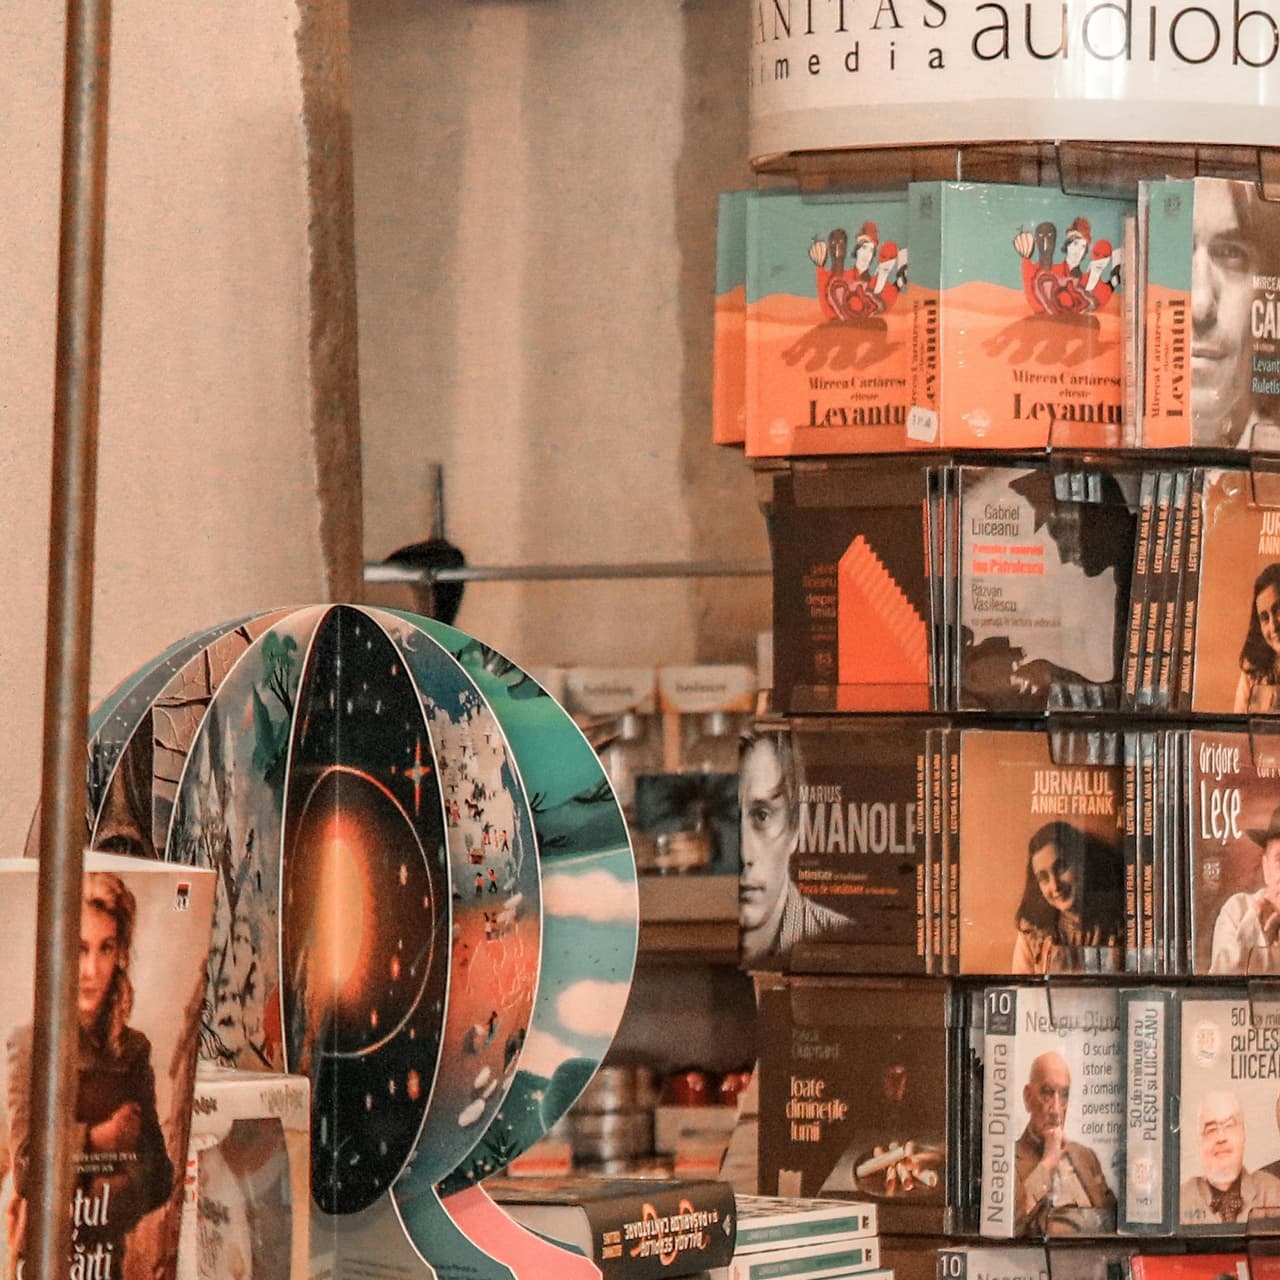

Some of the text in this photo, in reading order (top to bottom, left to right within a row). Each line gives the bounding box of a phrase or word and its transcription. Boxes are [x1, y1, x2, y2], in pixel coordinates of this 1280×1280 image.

[809, 400, 906, 428] Levantu
[1013, 393, 1122, 424] Levantu
[985, 504, 1020, 521] Gabriel
[971, 519, 1020, 537] Liiceanu
[1199, 742, 1239, 781] Grigore
[798, 785, 843, 804] MARIUS
[1031, 770, 1113, 796] JURNALUL
[1030, 795, 1113, 816] ANNEI FRANK
[1200, 780, 1242, 846] Leșe
[988, 992, 1011, 1015] 10
[1025, 1011, 1079, 1038] Neagu
[1231, 1007, 1245, 1026] 50
[1083, 1042, 1121, 1056] O scurt
[1143, 1008, 1158, 1077] LIICEANU
[1230, 1034, 1246, 1051] cu
[1083, 1062, 1112, 1076] istorie
[1130, 1040, 1143, 1087] minute
[1131, 1090, 1142, 1106] de
[1081, 1122, 1103, 1134] celor
[1130, 1110, 1142, 1128] 50
[1144, 1095, 1158, 1141] PLEȘU
[988, 1042, 1010, 1224] Neagu Djuvara
[72, 1183, 110, 1241] țul
[940, 1255, 962, 1278] 10
